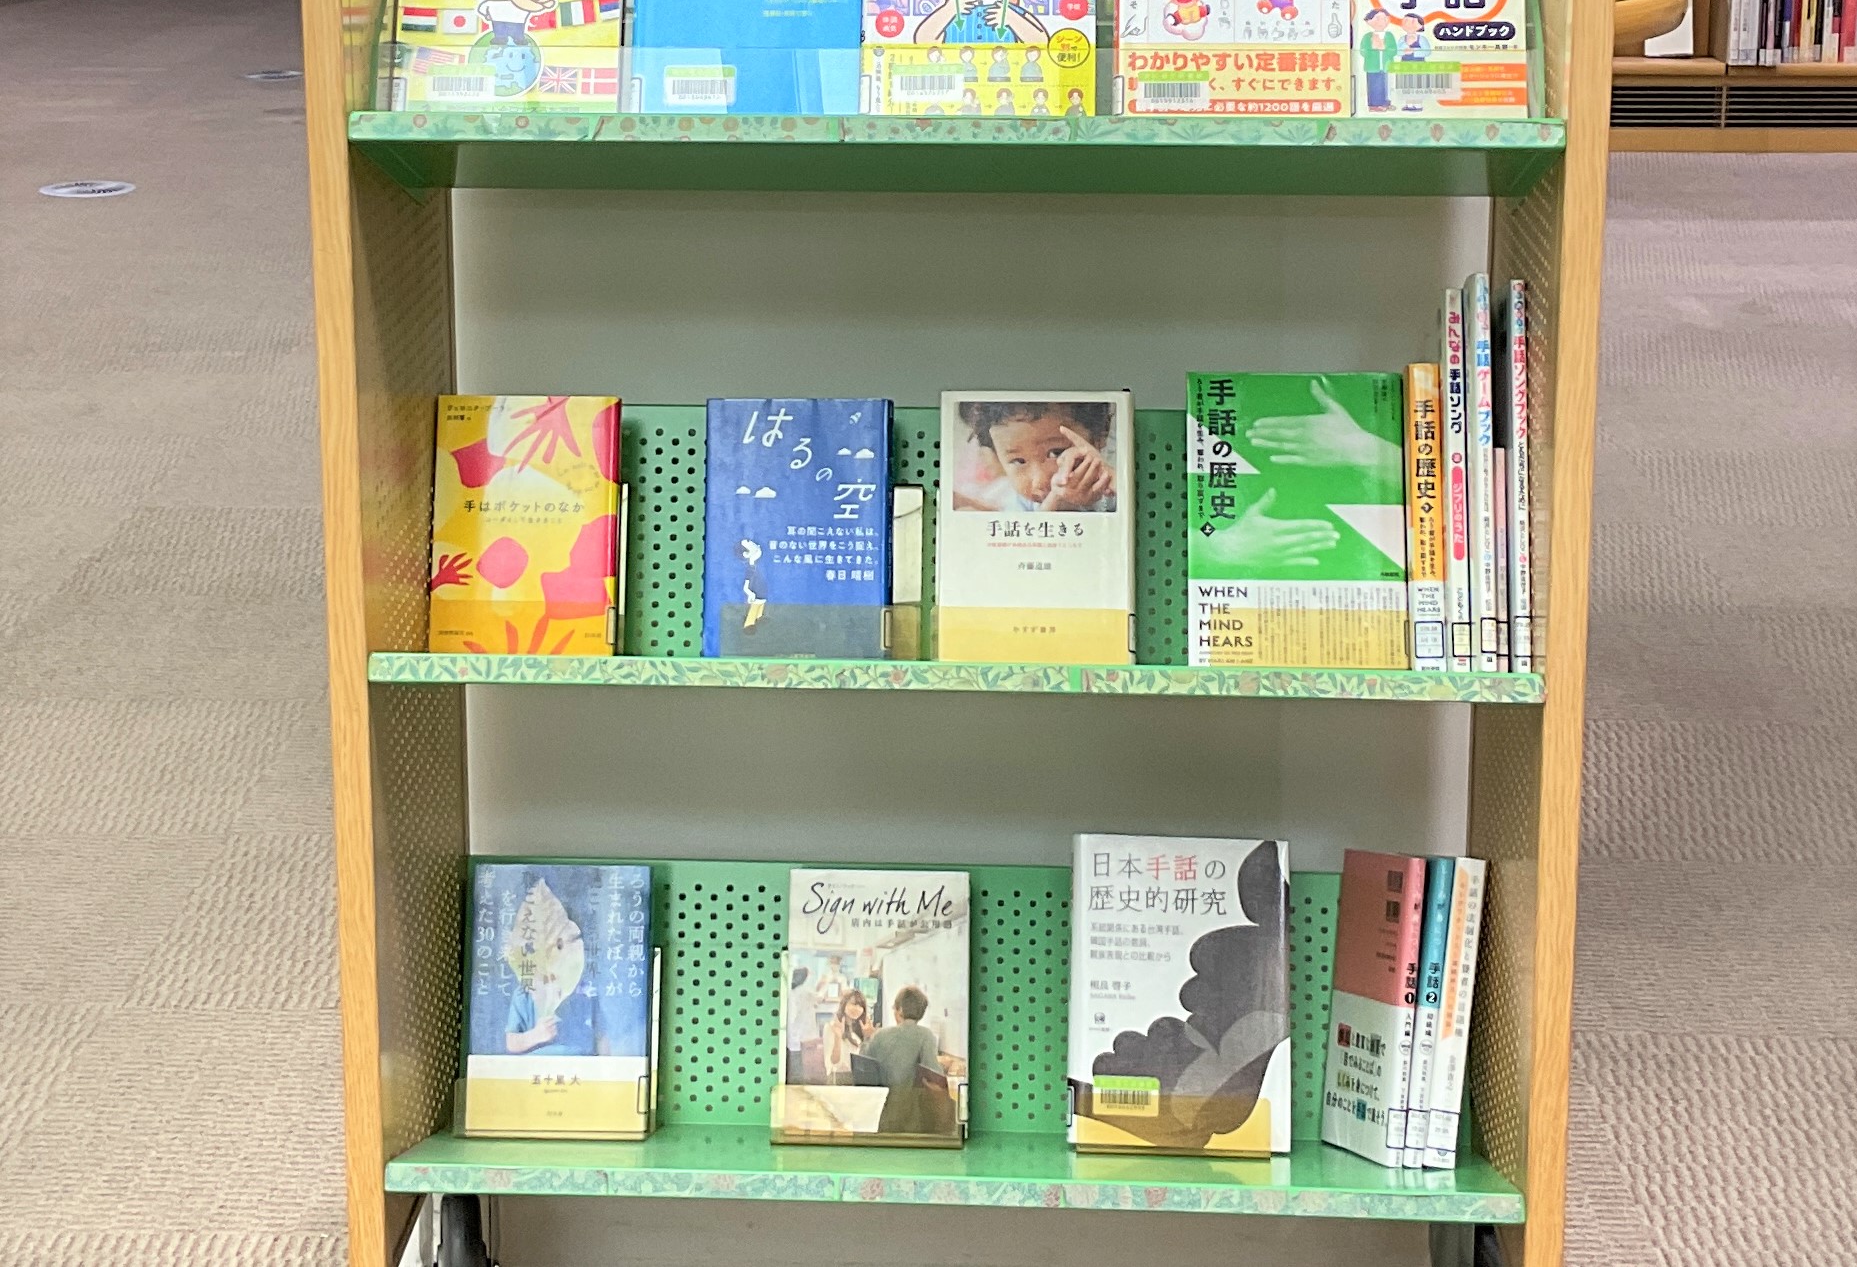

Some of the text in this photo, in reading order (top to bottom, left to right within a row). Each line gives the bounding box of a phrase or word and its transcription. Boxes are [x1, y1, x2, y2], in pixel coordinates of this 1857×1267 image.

[1438, 24, 1511, 38] ハンドブック
[1128, 52, 1341, 72] わかりやすい定番辞典
[1207, 378, 1237, 520] 手話の歴史
[1414, 400, 1436, 499] 手話の歴史
[464, 500, 585, 513] 手はポケットのなか
[987, 520, 1084, 538] 手話を生きる
[1198, 586, 1248, 598] WHEN
[1198, 603, 1231, 615] THE
[1199, 619, 1243, 631] MIND
[1199, 636, 1253, 647] HEARS
[1093, 852, 1226, 881] 日本手話の
[803, 881, 953, 934] Sign with Me
[1087, 885, 1228, 916] 歴史的研究
[476, 869, 496, 996] 考えた30のこと
[606, 872, 624, 996] 生まれたぼくが
[627, 873, 645, 997] ろうの両親から
